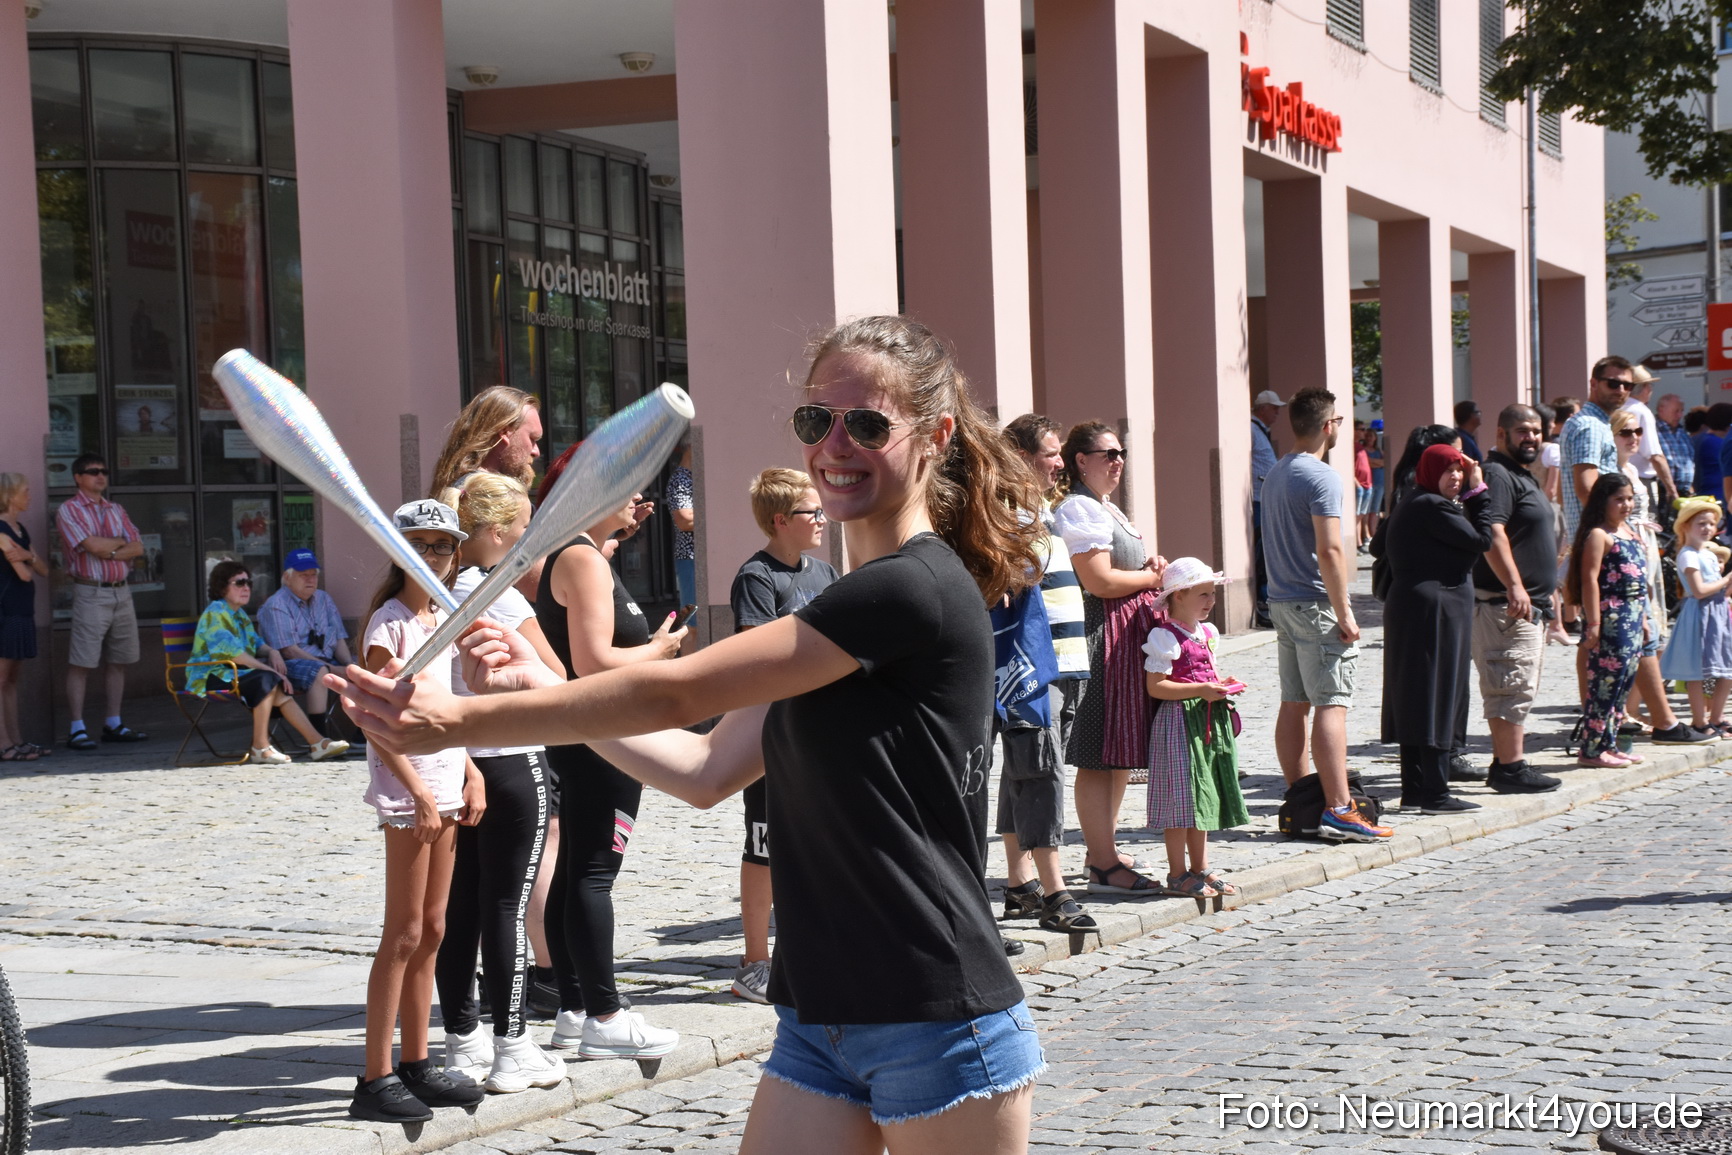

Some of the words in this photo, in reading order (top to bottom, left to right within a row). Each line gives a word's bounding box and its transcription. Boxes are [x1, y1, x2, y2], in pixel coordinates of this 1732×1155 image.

[1249, 66, 1342, 153] Sparkasse
[519, 254, 650, 306] wochenblatt
[520, 305, 574, 332] Ticketshop
[575, 318, 585, 330] in
[587, 317, 603, 332] der
[605, 316, 651, 339] Sparkasse
[1669, 327, 1700, 342] AOK
[417, 503, 446, 524] LA
[532, 767, 544, 783] NO
[537, 785, 547, 827] NEEDED
[529, 828, 545, 864] WORDS
[525, 865, 536, 880] NO
[517, 882, 532, 919] NEEDED
[516, 920, 525, 955] WORDS
[514, 957, 525, 971] NO
[509, 974, 524, 1012] NEEDED
